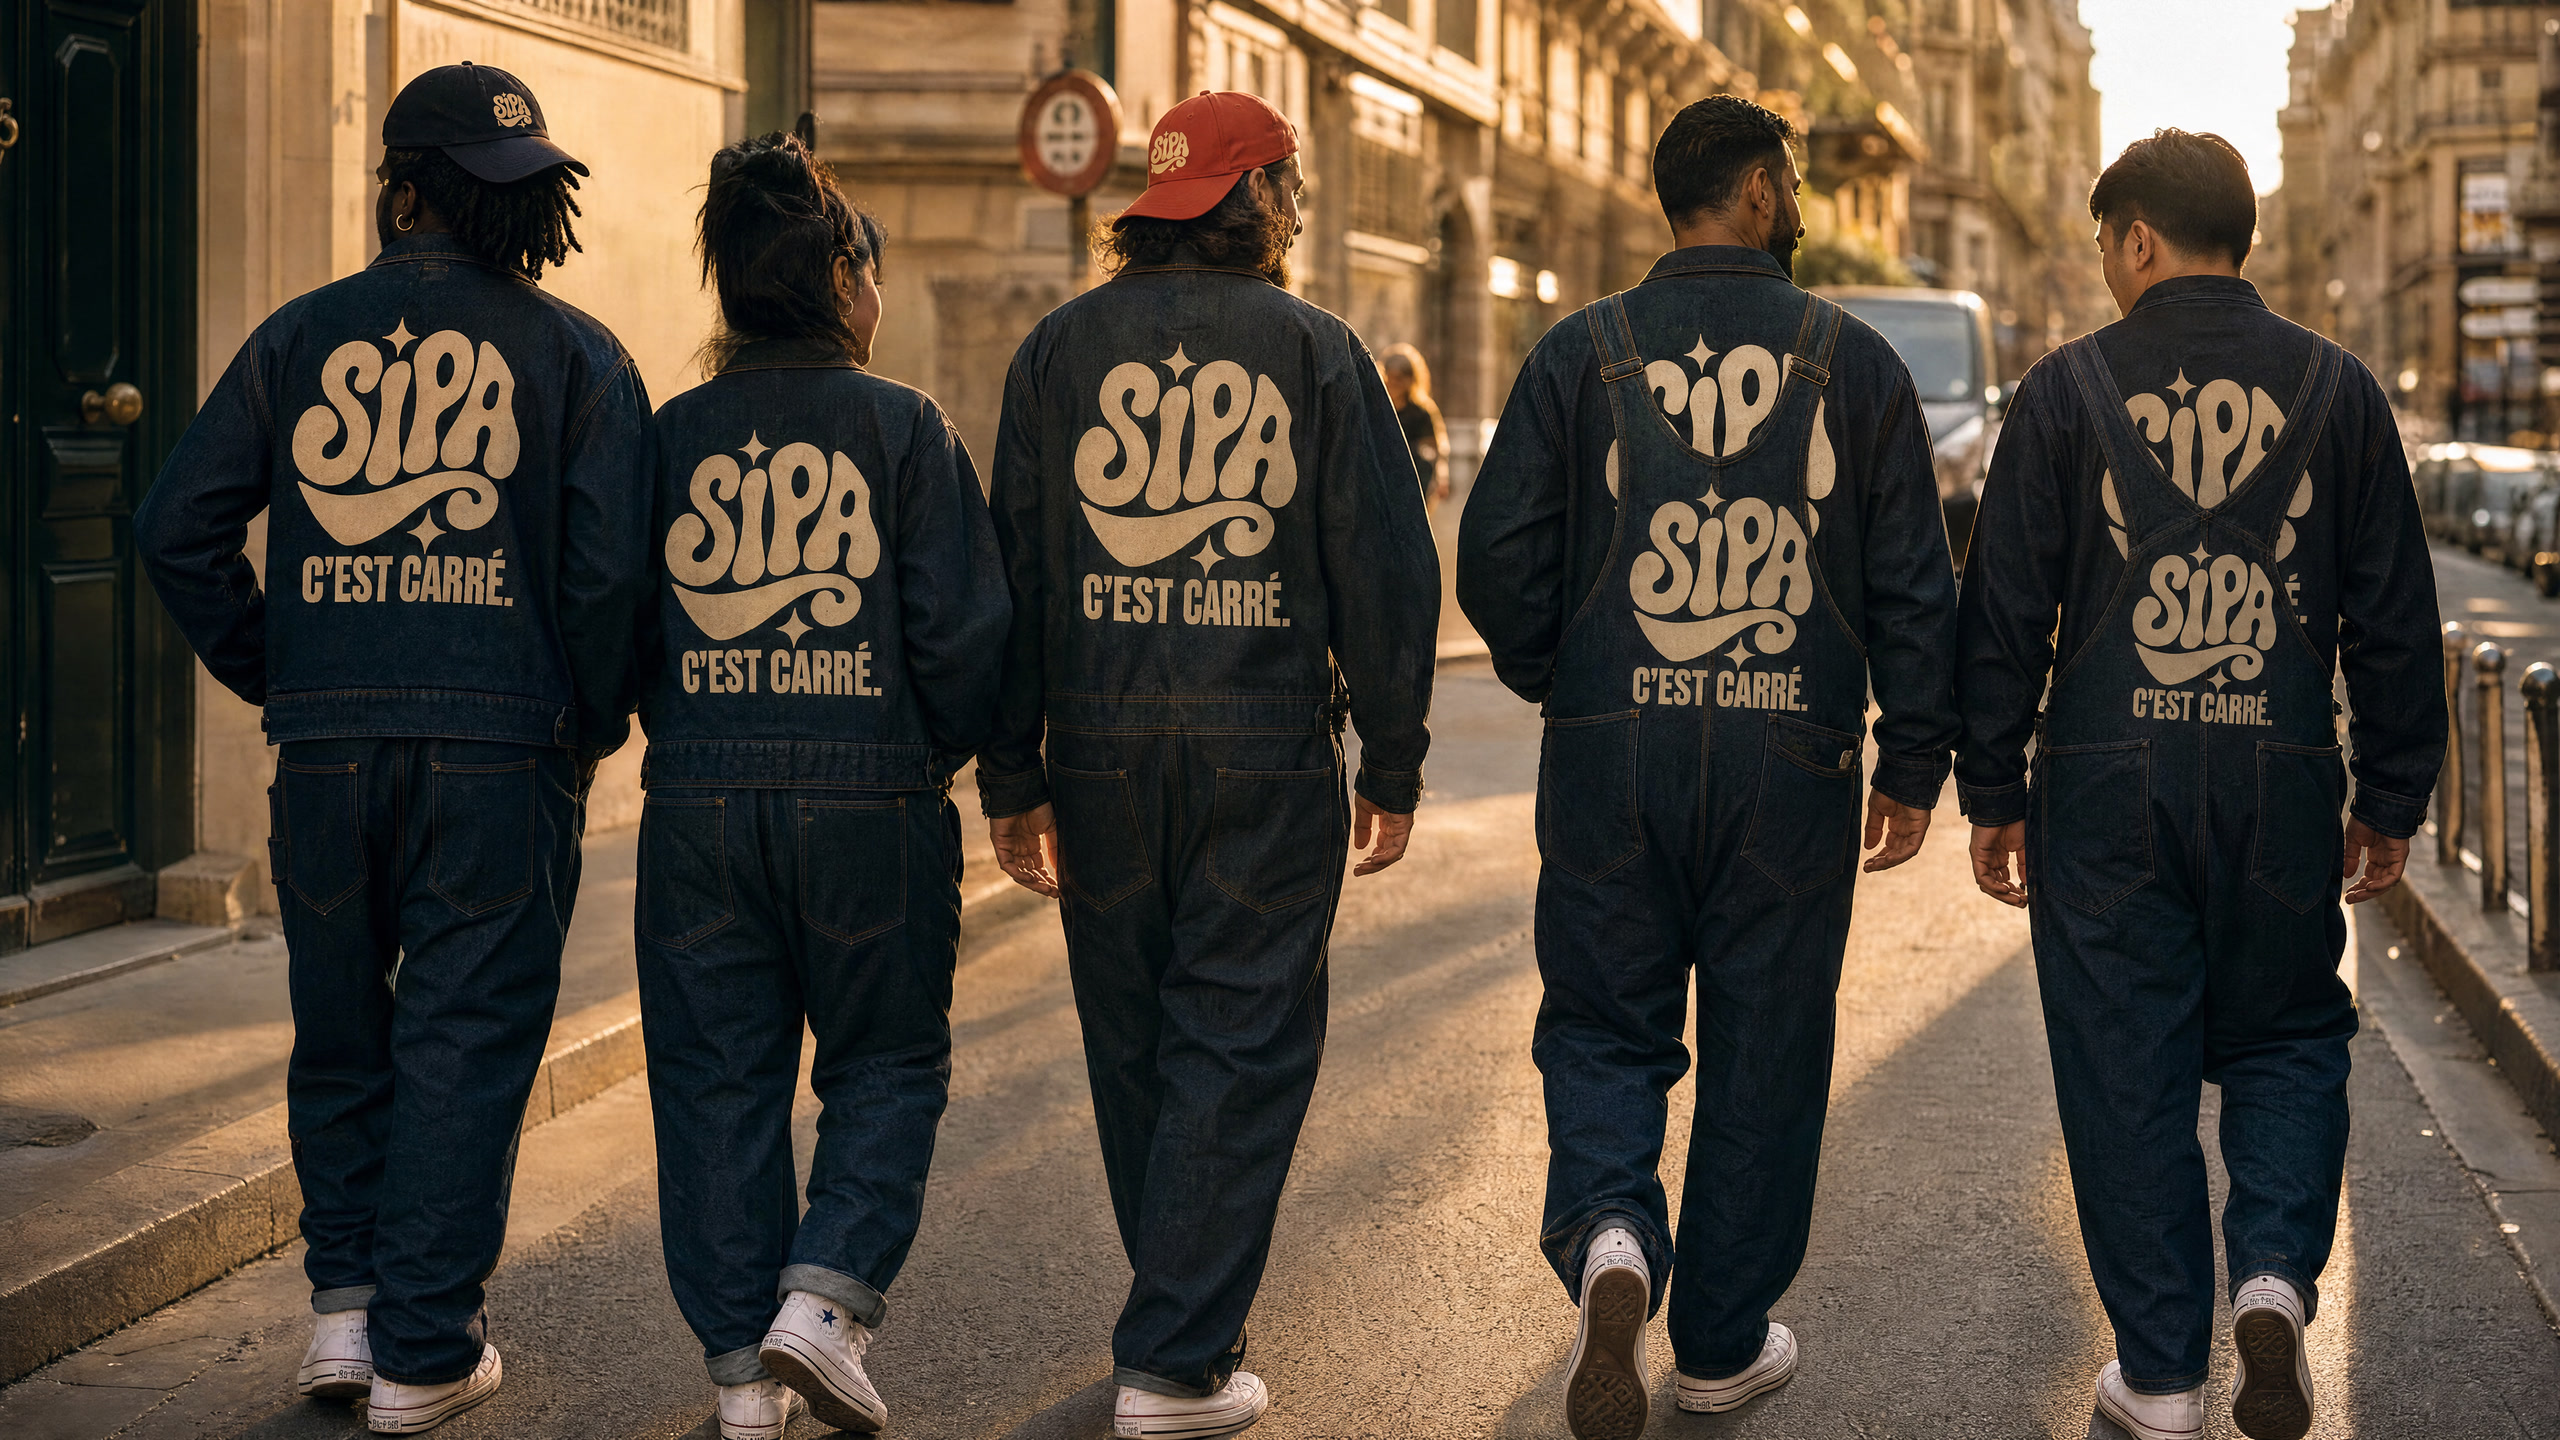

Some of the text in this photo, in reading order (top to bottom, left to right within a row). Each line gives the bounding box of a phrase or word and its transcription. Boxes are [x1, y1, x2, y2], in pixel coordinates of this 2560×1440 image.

[302, 549, 514, 607] C'EST CARRÉ.
[1082, 571, 1291, 628] C'EST CARRÉ.
[681, 641, 883, 697] C'EST CARRÉ.
[1632, 665, 1808, 712] C'EST CARRÉ.
[2132, 687, 2273, 726] C'EST CARRÉ.
